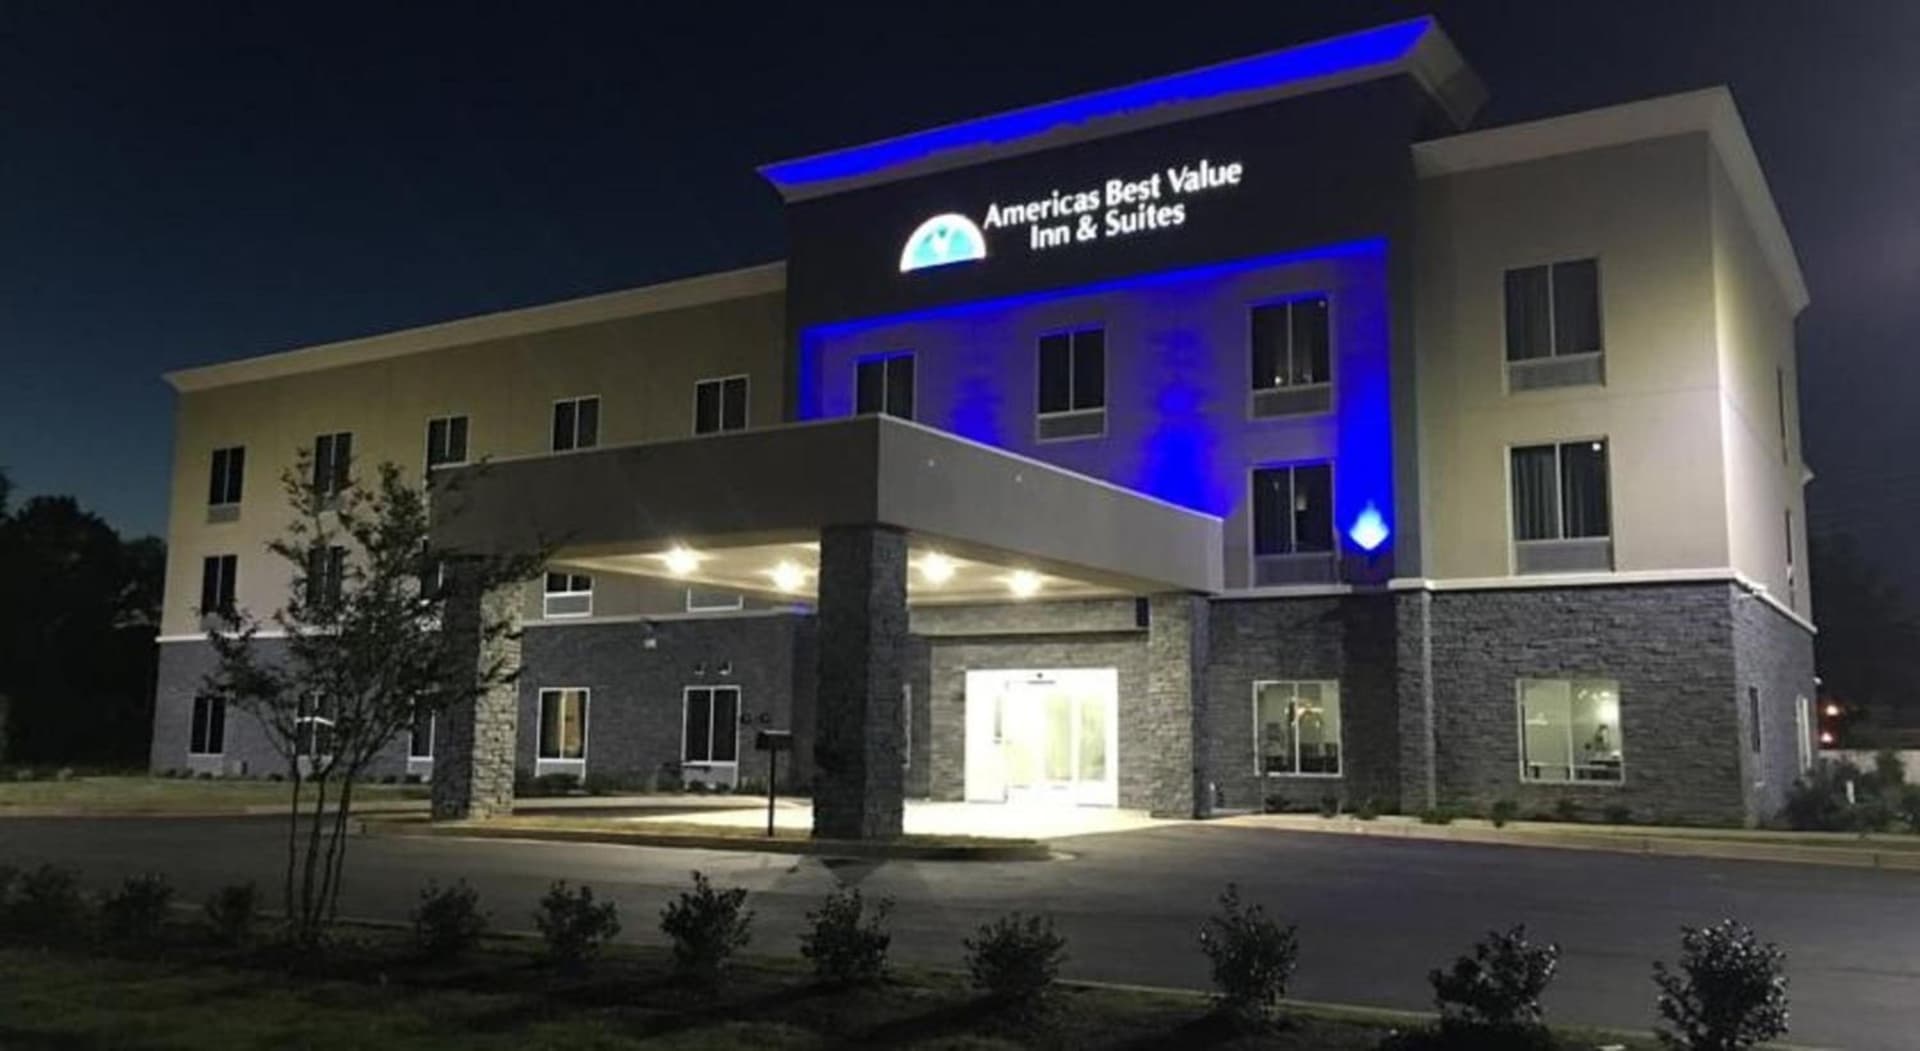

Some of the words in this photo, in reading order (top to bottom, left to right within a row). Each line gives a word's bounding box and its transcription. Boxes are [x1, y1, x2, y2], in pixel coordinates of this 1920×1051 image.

[983, 190, 1100, 230] Americas
[1106, 173, 1161, 207] Best
[1168, 159, 1243, 194] Value
[1030, 224, 1070, 250] Inn
[1076, 214, 1098, 242] &
[1105, 202, 1186, 238] Suites
